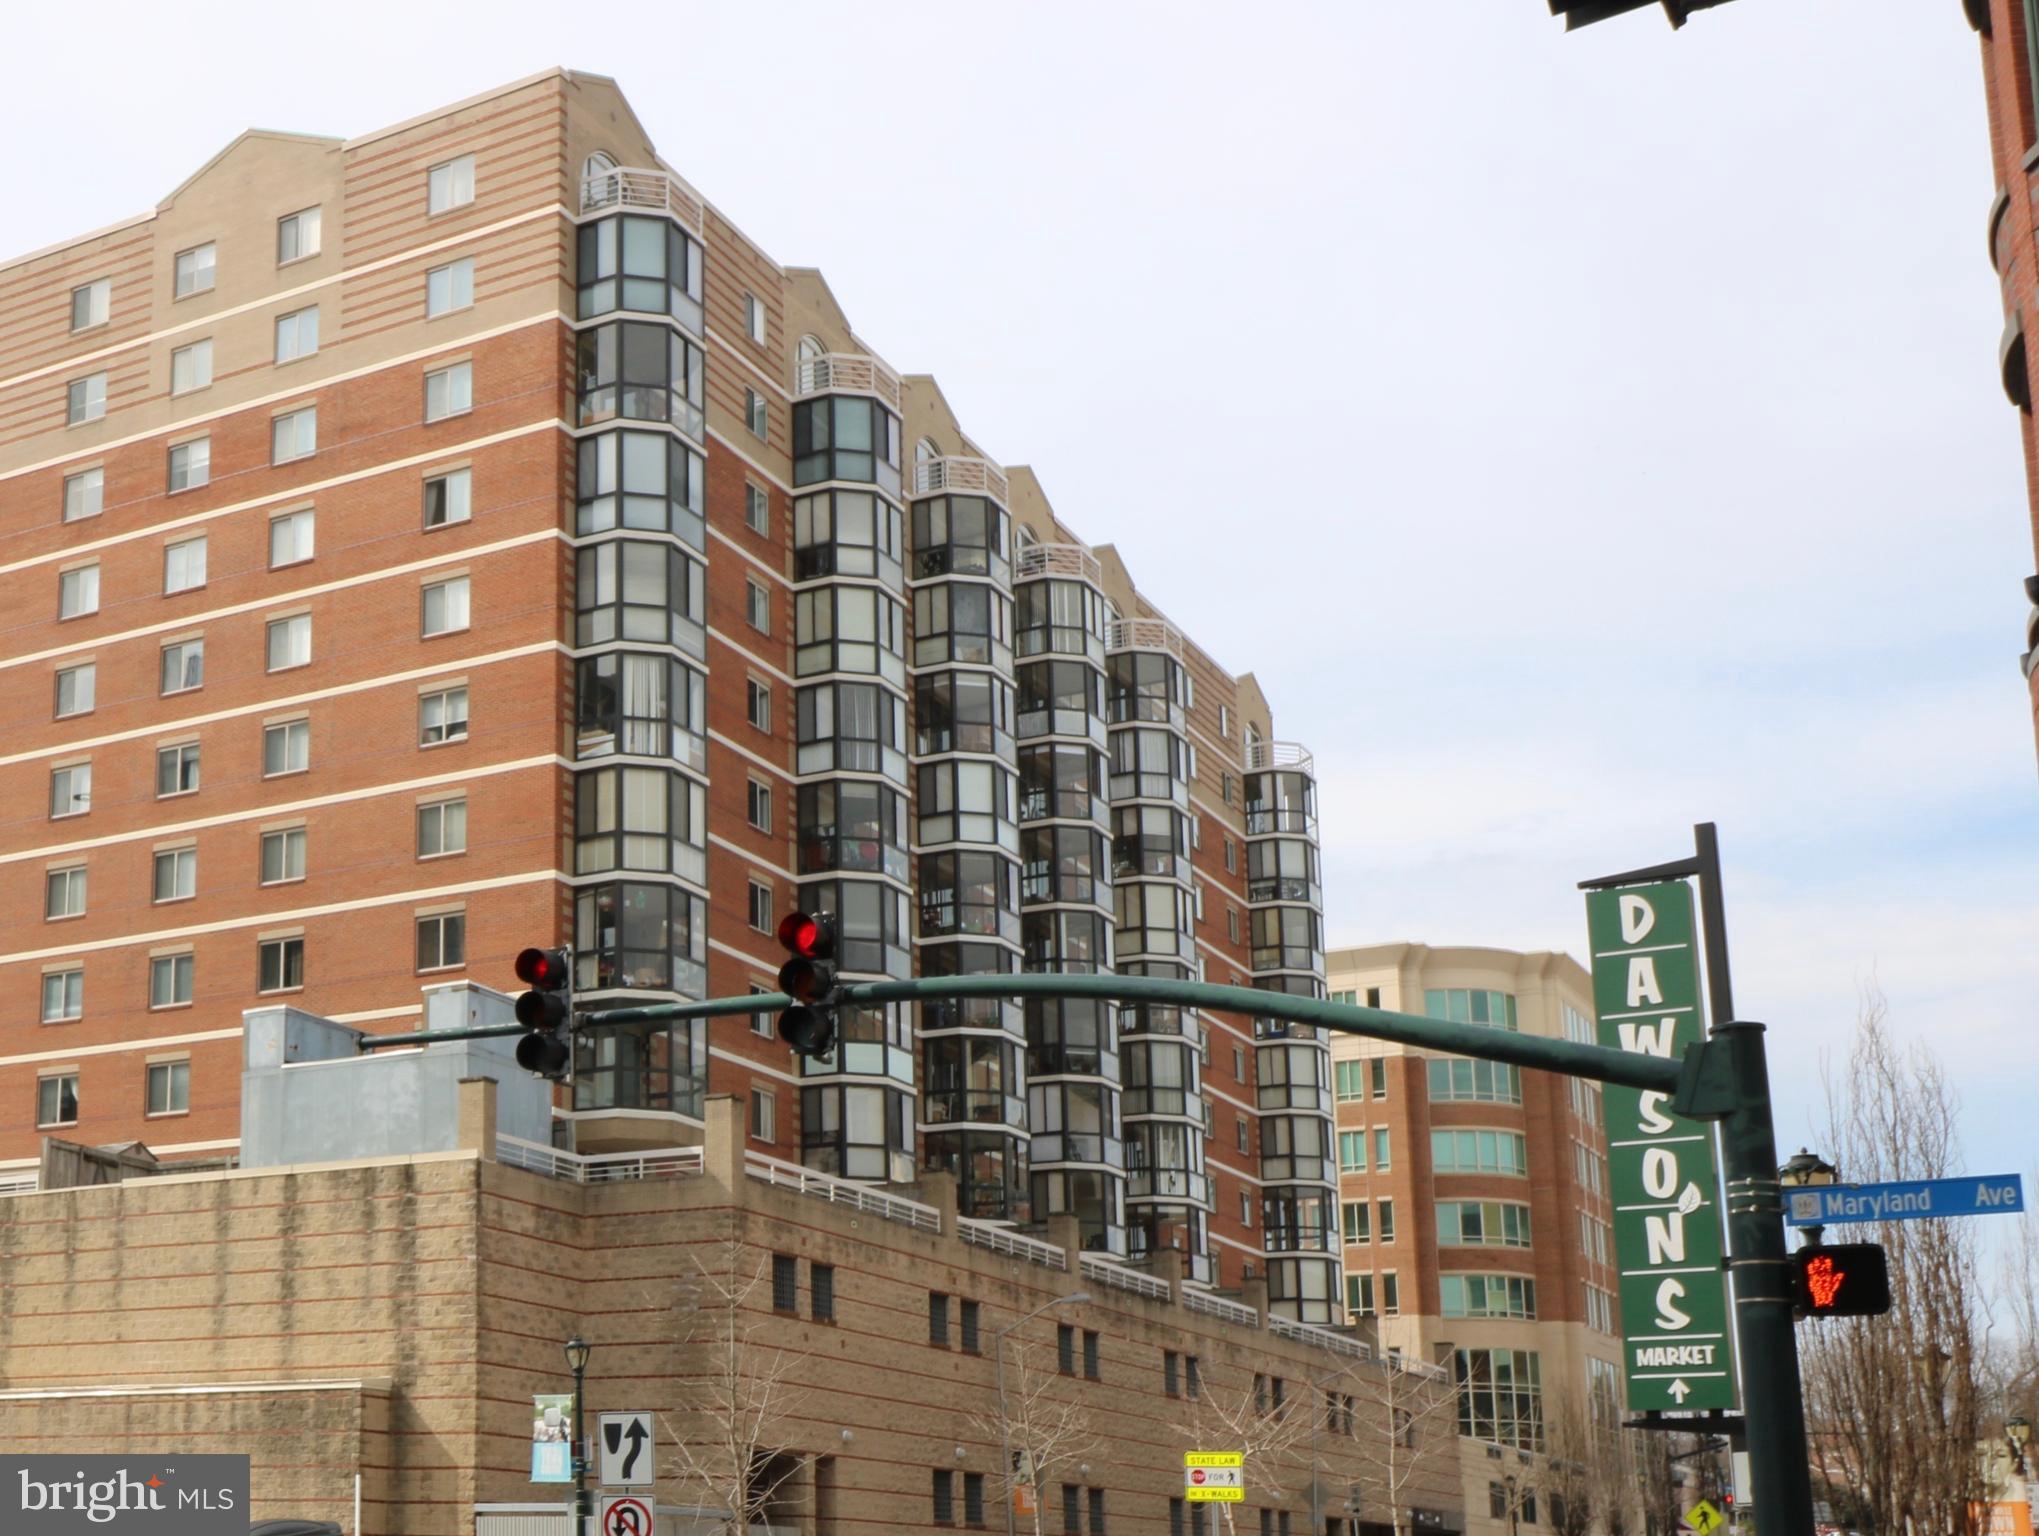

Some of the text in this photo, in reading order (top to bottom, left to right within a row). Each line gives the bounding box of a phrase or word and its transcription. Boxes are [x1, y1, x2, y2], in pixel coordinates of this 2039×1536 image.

[1826, 1183, 2016, 1219] Maryland Ave
[1636, 1345, 1714, 1367] MARKET
[1190, 1456, 1235, 1464] STATE LAW
